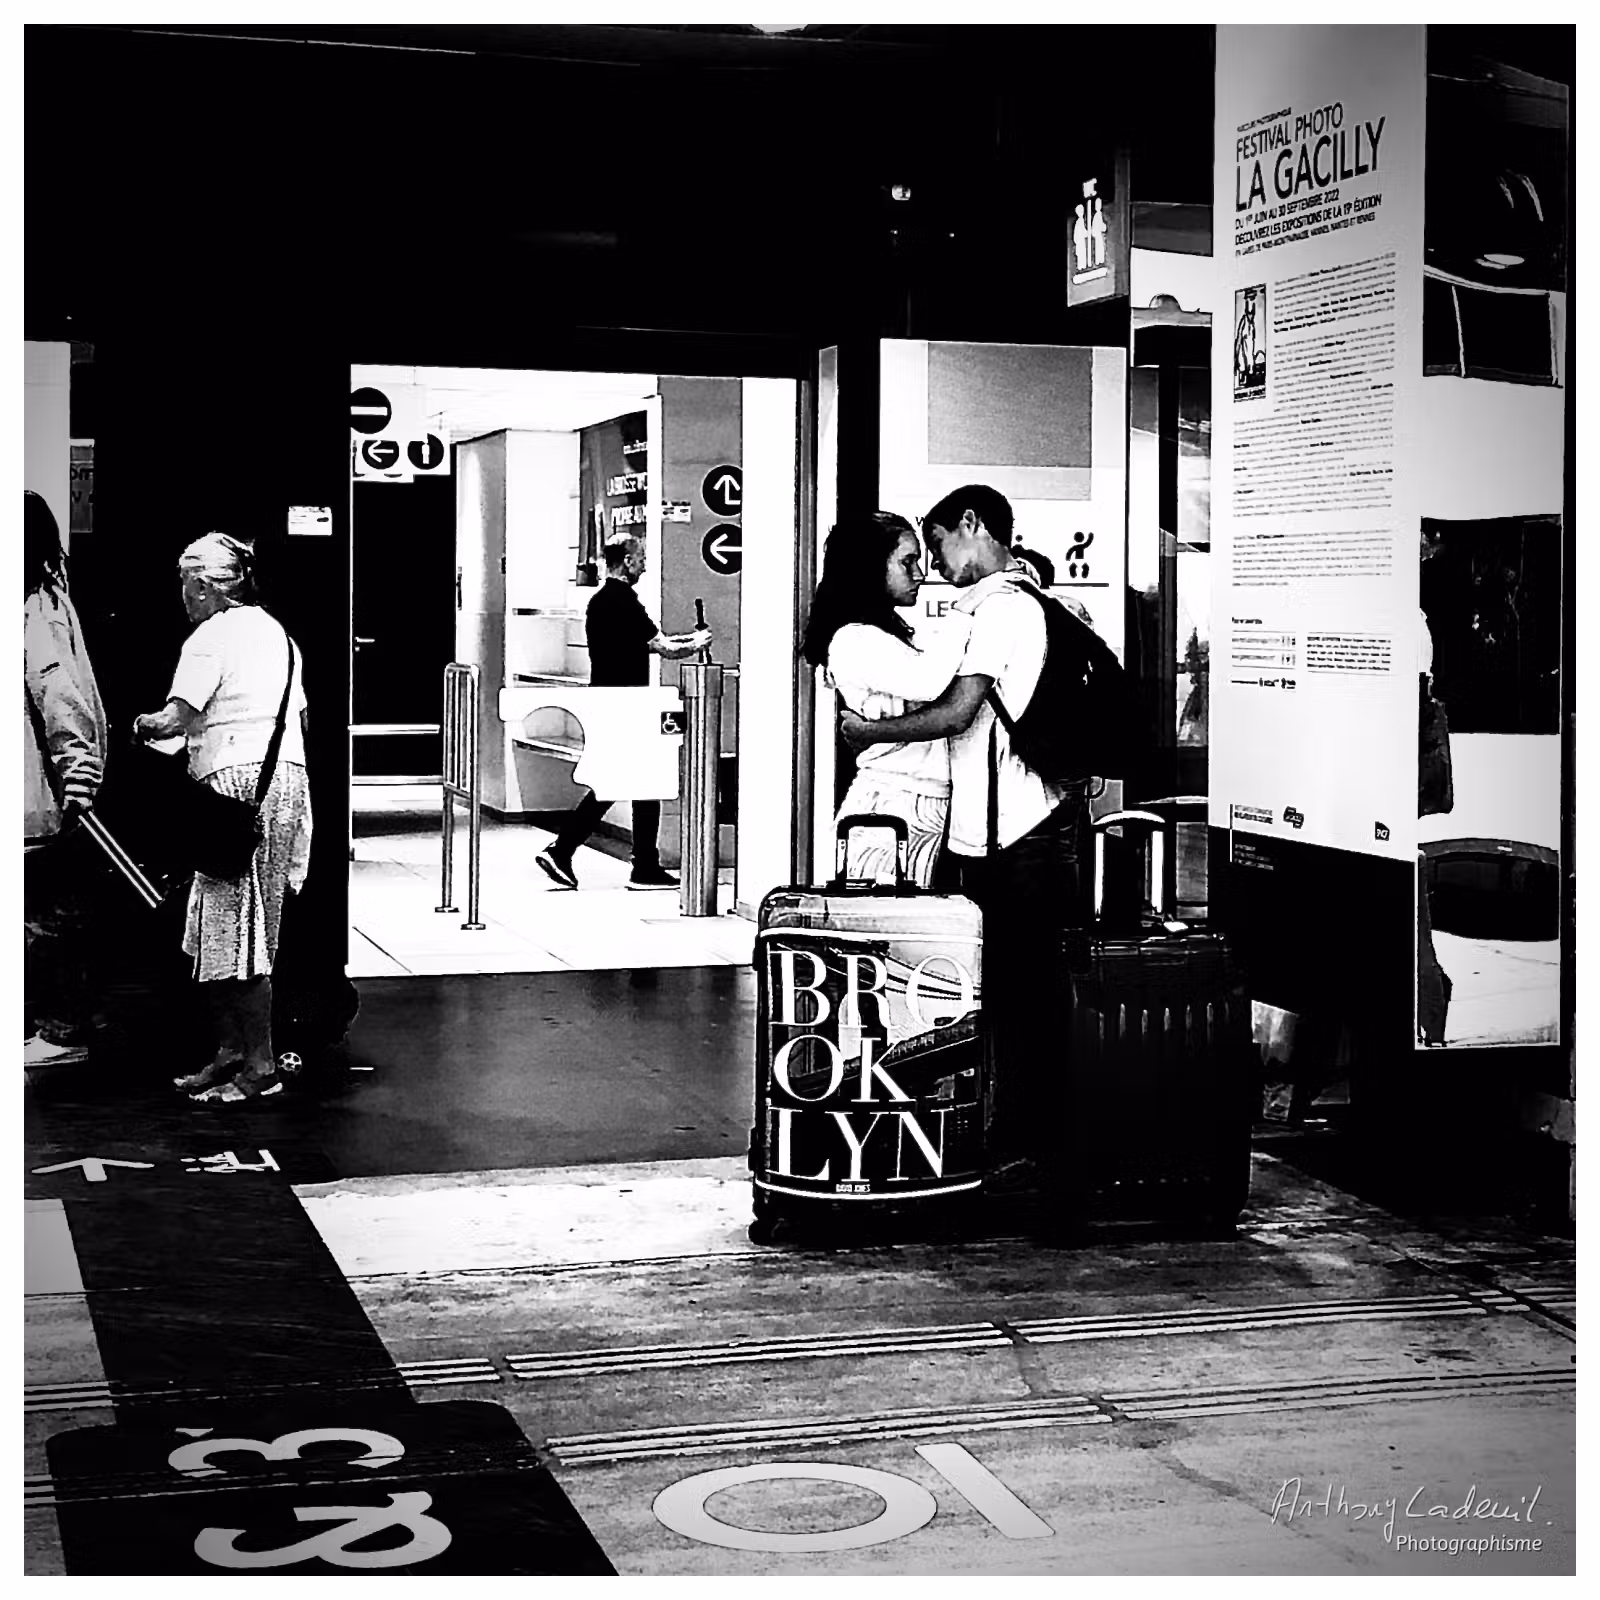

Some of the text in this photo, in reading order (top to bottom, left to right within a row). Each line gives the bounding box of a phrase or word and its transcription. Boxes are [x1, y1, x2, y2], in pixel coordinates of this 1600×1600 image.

[1236, 116, 1386, 212] LA GACILLY
[1237, 121, 1292, 162] FESTIVAL
[1295, 102, 1343, 142] PHOTO
[1254, 210, 1267, 224] JUIN
[1268, 207, 1278, 219] AU
[1279, 204, 1286, 217] 30
[1287, 193, 1323, 214] SEPTEMBRE
[1324, 188, 1340, 204] 2022
[1271, 222, 1281, 235] LES
[1282, 210, 1322, 233] EXPOSITIONS
[1323, 207, 1333, 221] DE
[1333, 205, 1342, 218] LA
[1354, 193, 1382, 213] ÉDITION
[768, 949, 975, 1031] BRO
[773, 1034, 917, 1102] OK
[765, 1105, 955, 1182] LYN
